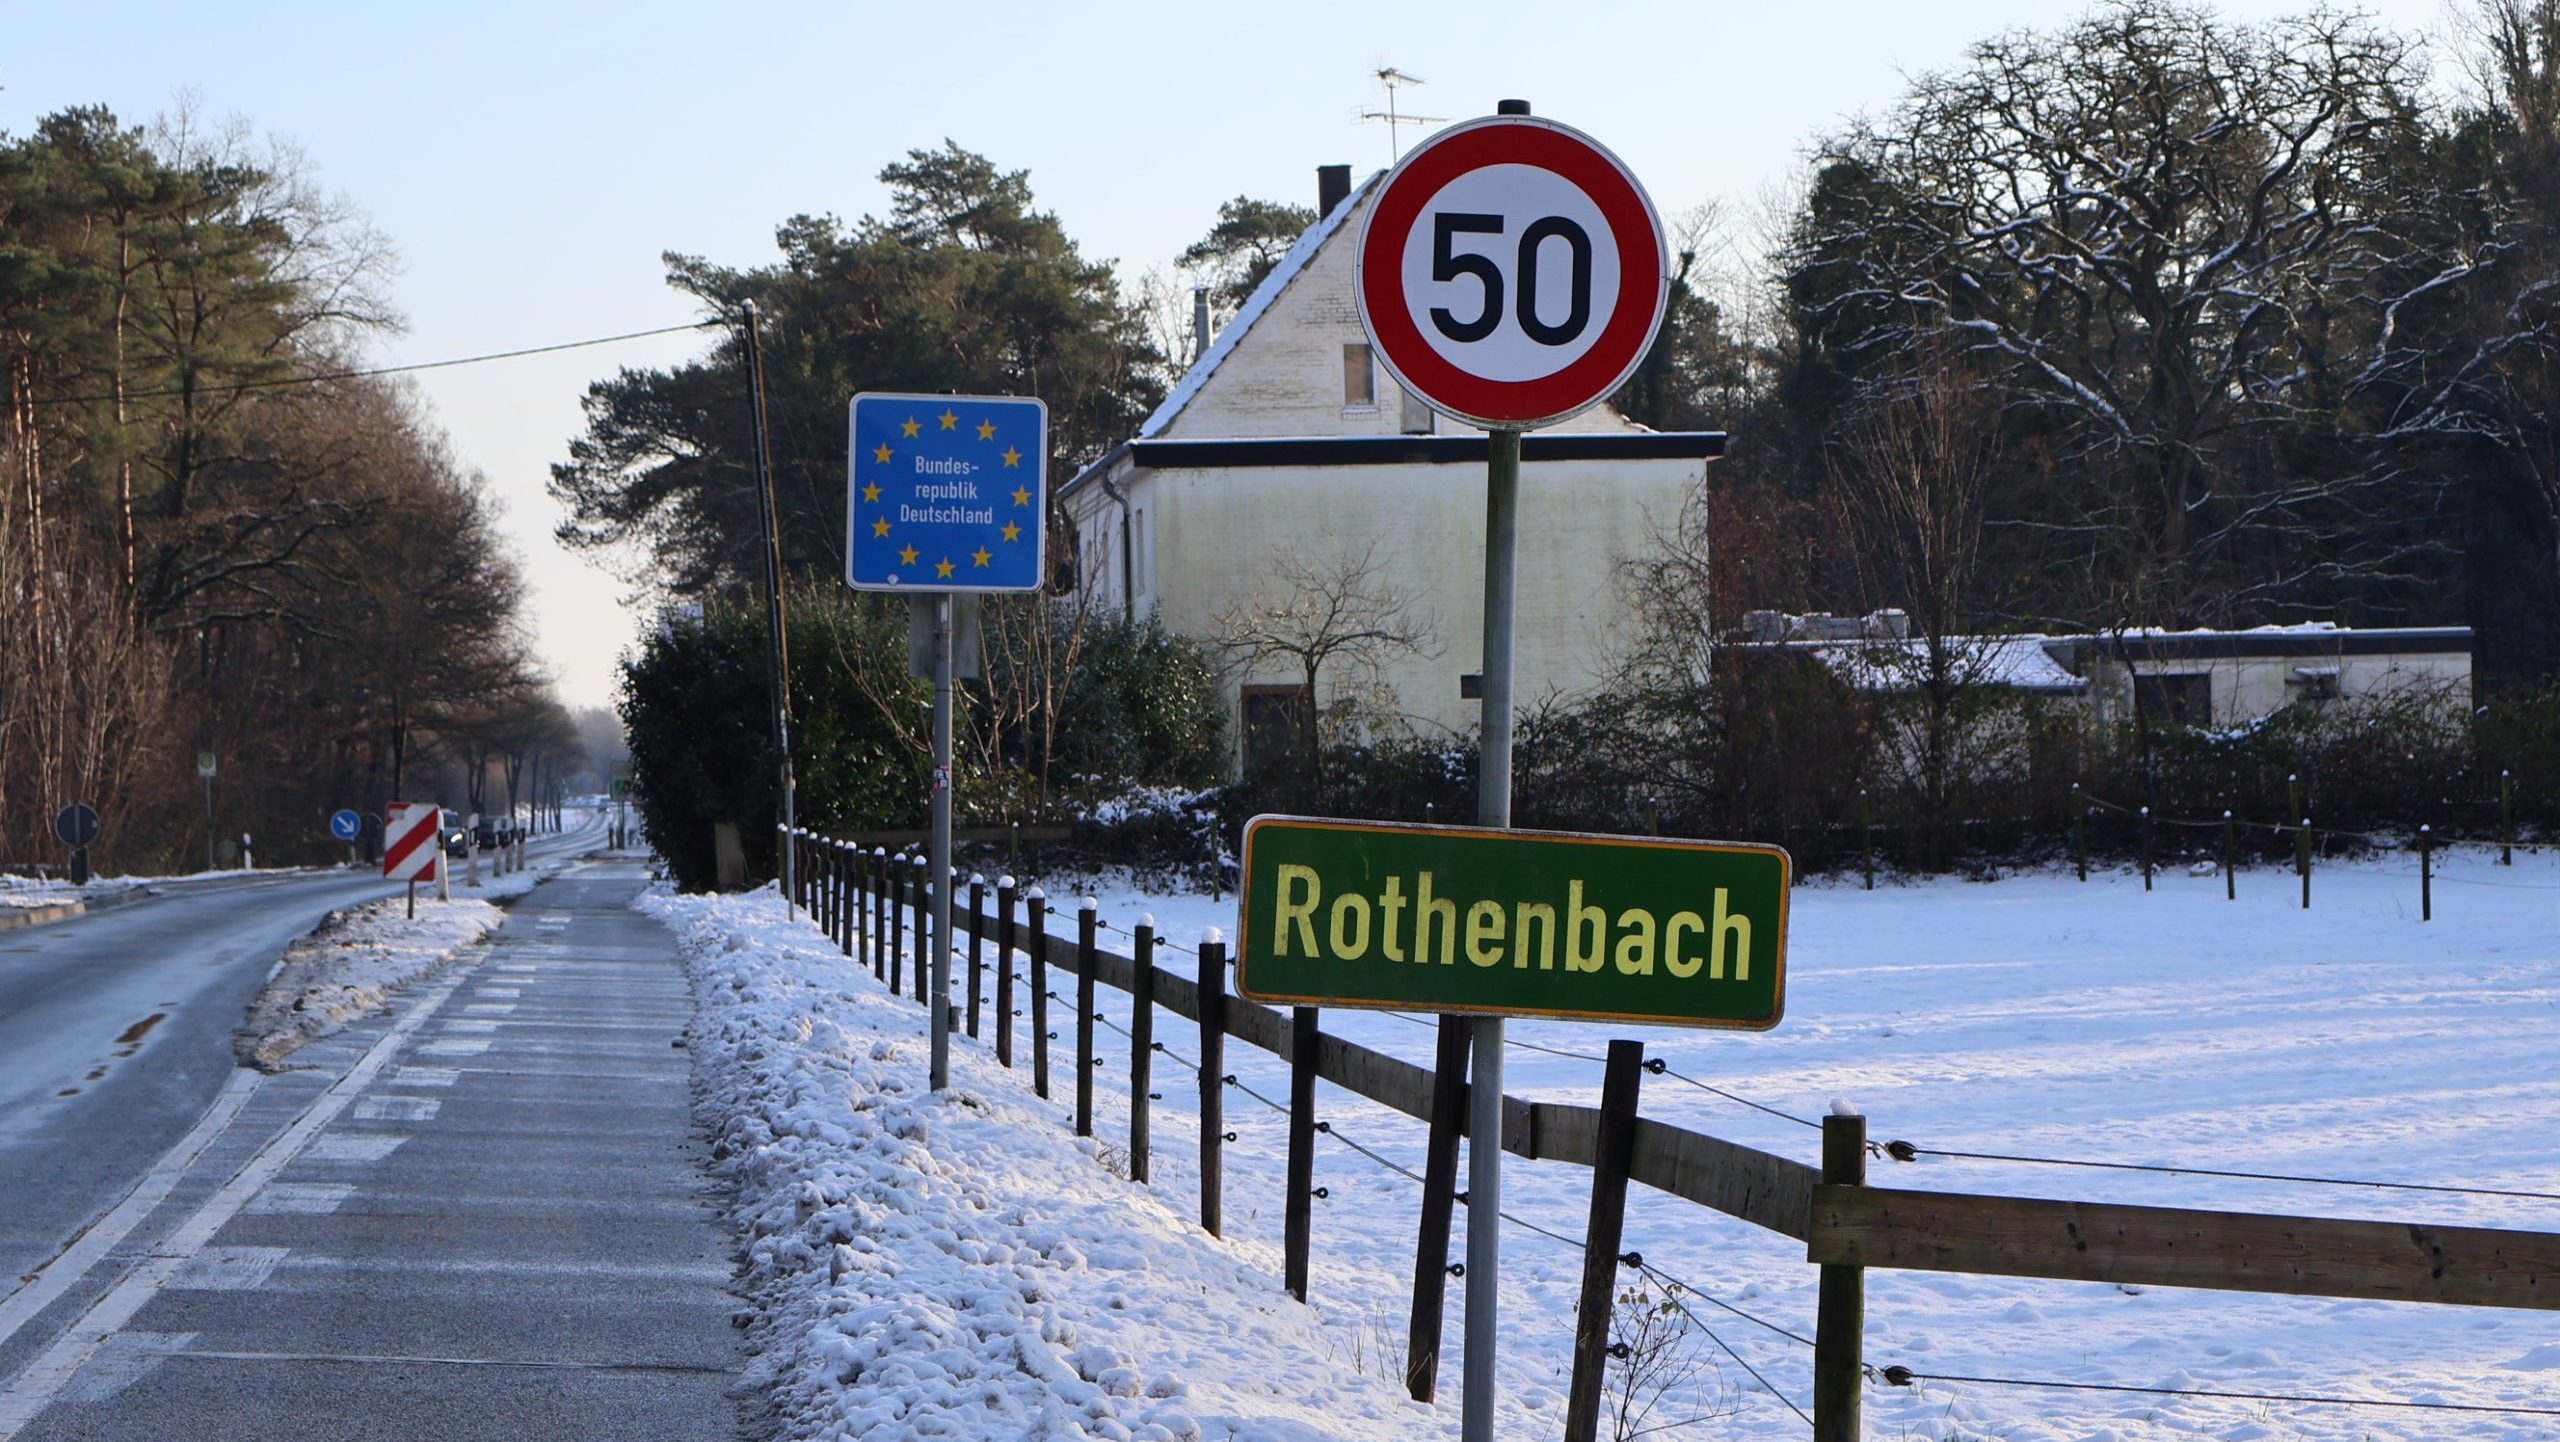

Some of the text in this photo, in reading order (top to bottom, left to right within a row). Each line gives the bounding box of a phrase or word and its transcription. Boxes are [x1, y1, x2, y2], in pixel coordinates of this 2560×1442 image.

[1430, 212, 1592, 346] 50
[915, 456, 979, 475] Bundes-
[915, 481, 978, 502] republik
[900, 504, 993, 525] Deutschland
[1273, 863, 1752, 981] Rothenbach
